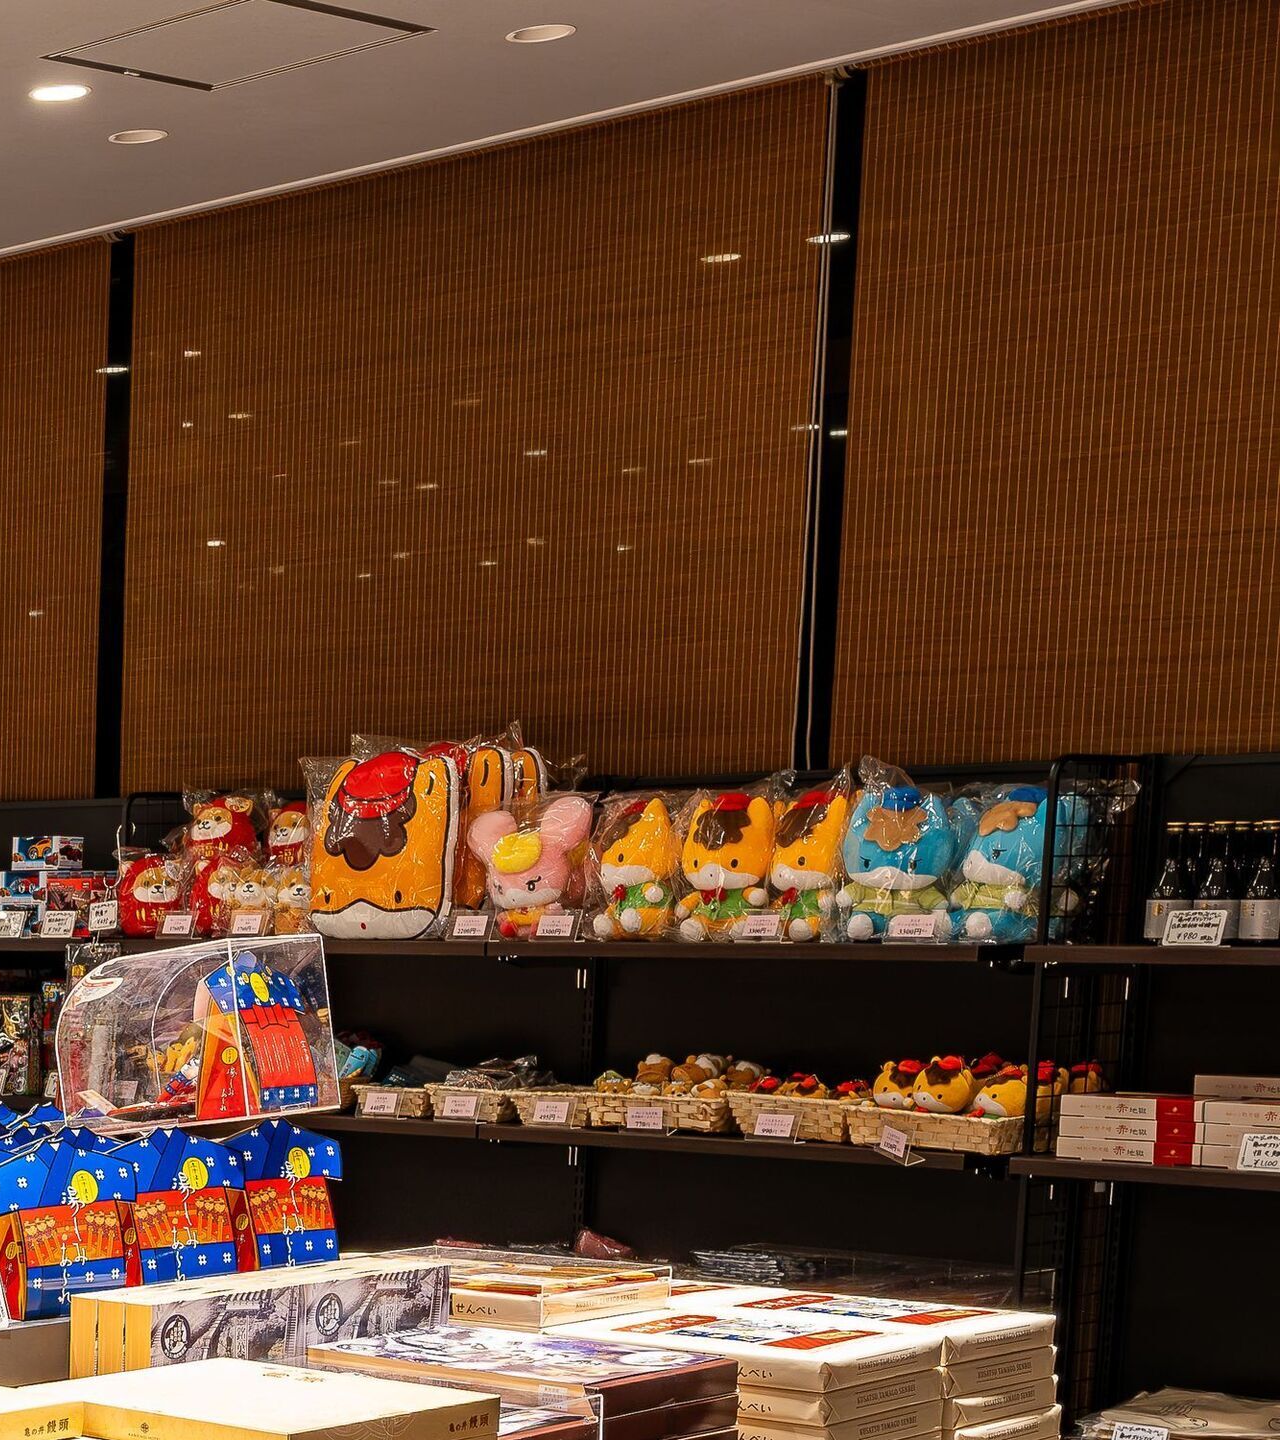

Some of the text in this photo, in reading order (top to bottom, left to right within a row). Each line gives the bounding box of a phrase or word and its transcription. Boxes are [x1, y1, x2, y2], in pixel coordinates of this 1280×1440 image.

[456, 1303, 497, 1315] せんべい
[738, 1367, 772, 1378] んべい
[25, 1418, 69, 1436] 亀の井饅頭
[449, 1413, 489, 1432] 亀の井饅頭
[859, 1416, 916, 1436] KUSATSU TAMAGO SENBEI
